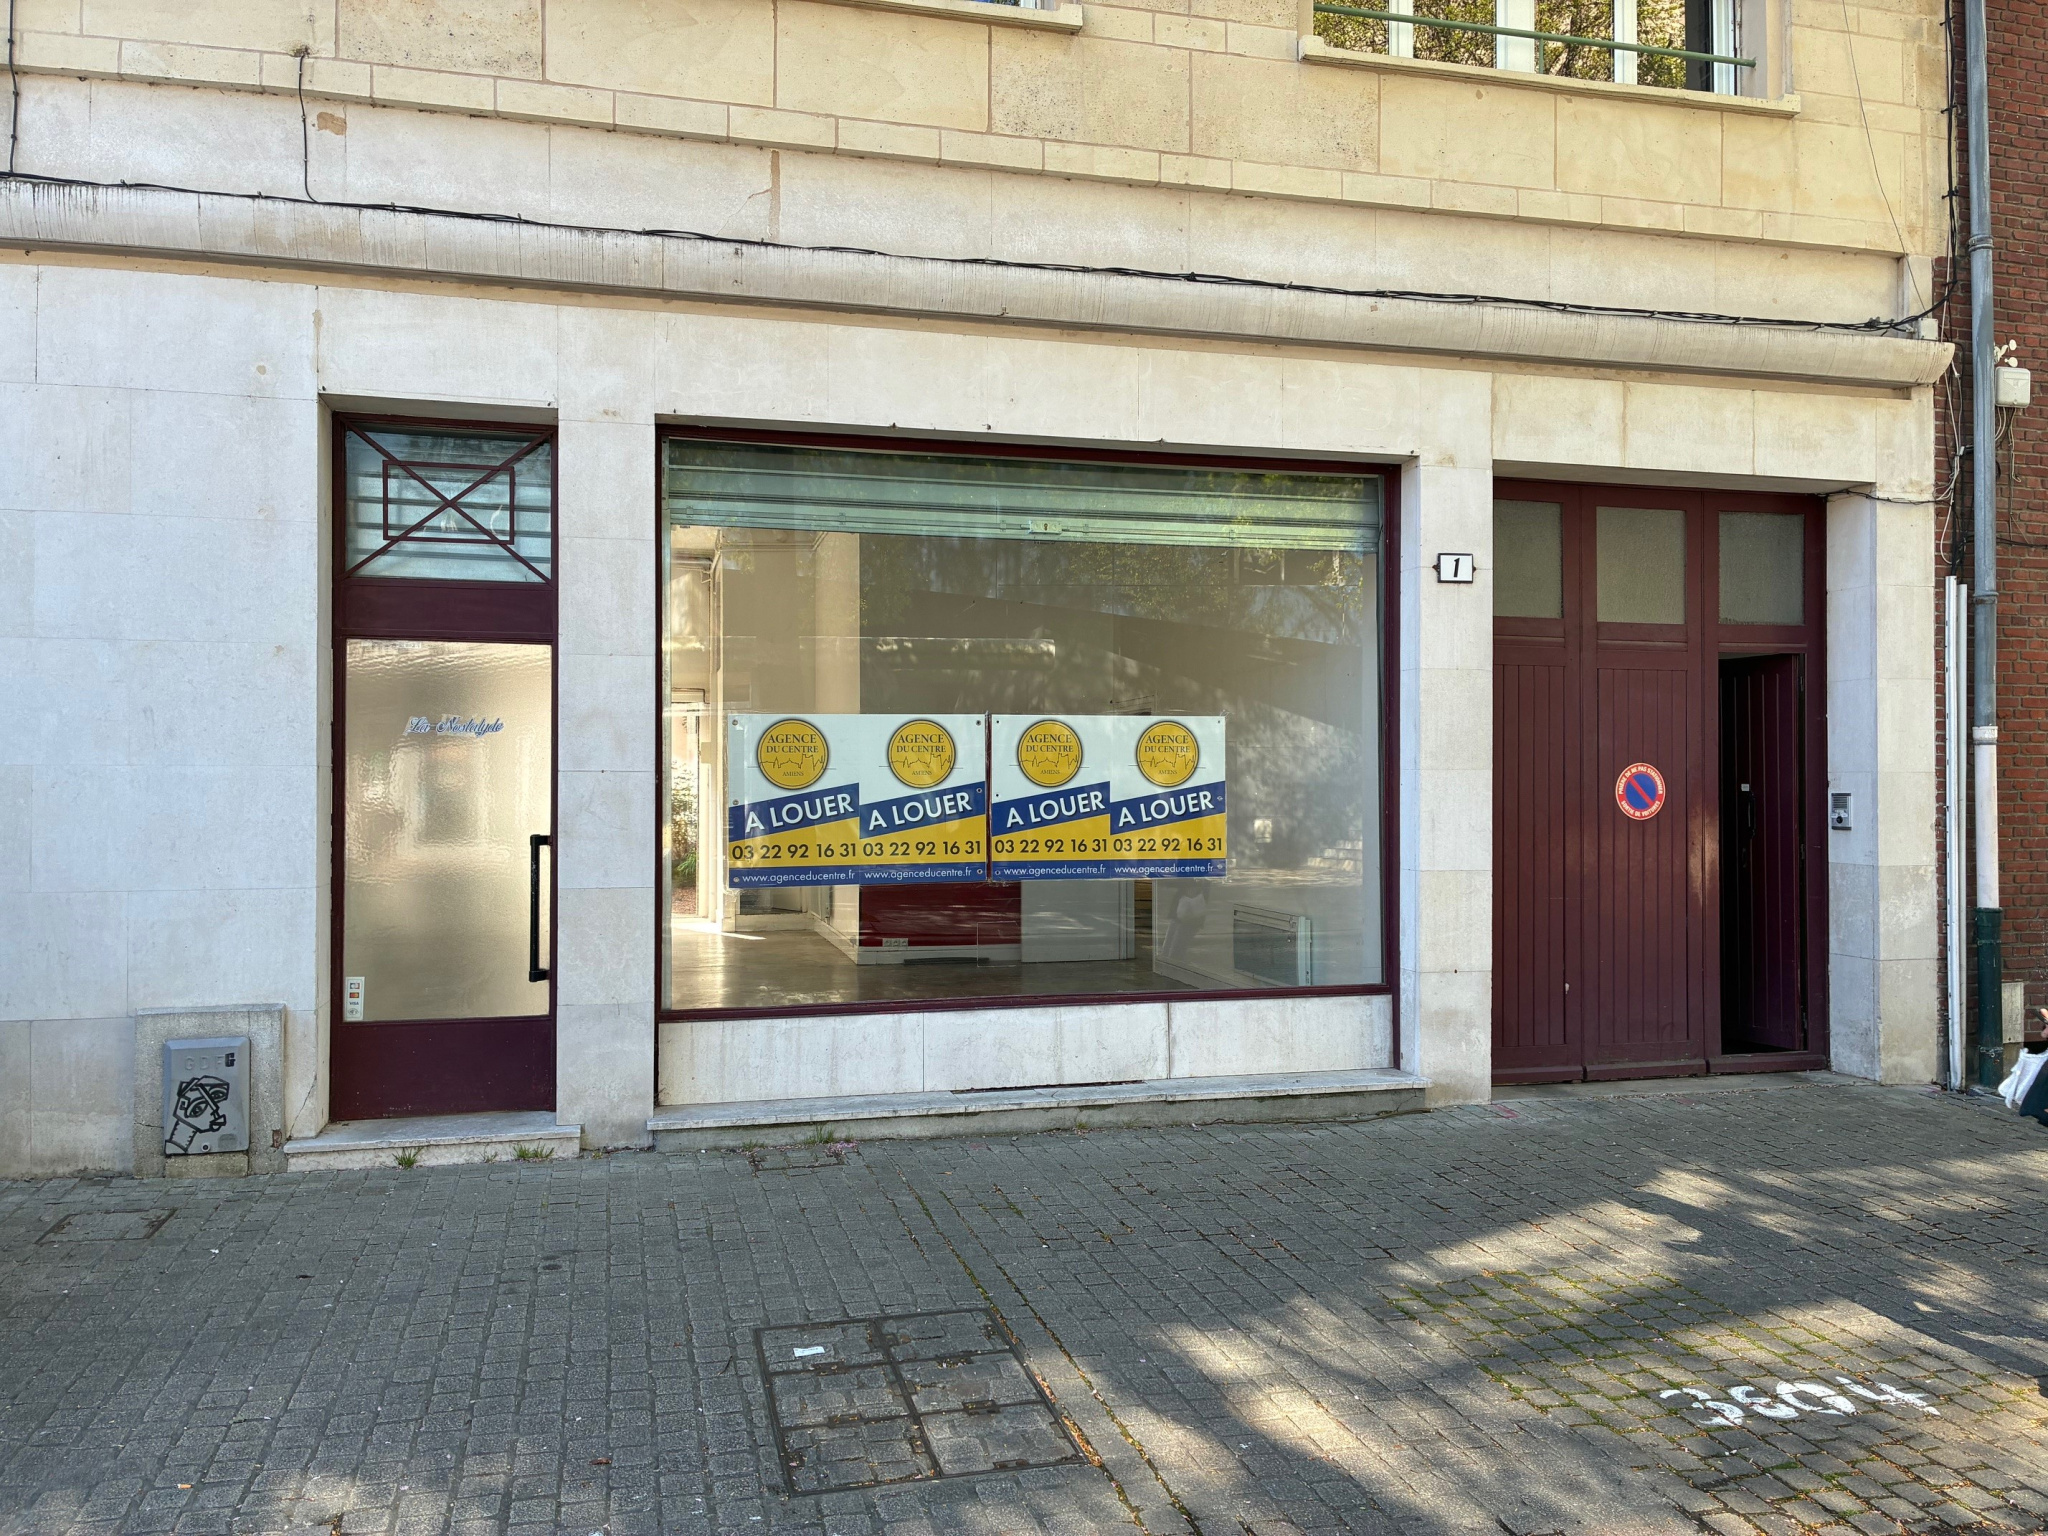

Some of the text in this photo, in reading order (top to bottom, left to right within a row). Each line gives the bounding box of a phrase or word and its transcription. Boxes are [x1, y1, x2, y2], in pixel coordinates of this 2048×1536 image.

[1453, 557, 1460, 578] 1
[768, 733, 816, 743] AGENCE
[898, 734, 944, 743] AGENCE
[1027, 734, 1071, 743] AGENCE
[1146, 735, 1188, 743] AGENCE
[782, 745, 819, 753] CENTRE
[1040, 744, 1074, 752] CENTRE
[1158, 745, 1190, 753] CENTRE
[745, 793, 854, 833] A LOUER
[869, 792, 972, 830] A LOUER
[1006, 791, 1105, 828] A LOUER
[1119, 791, 1214, 827] A LOUER
[732, 843, 856, 859] 03 22 92 16 31
[863, 841, 981, 856] 03 22 92 16 31
[995, 839, 1107, 853] 03 22 92 16 31
[1113, 838, 1222, 852] 03 22 92 16 31
[865, 867, 971, 880] www.agenceducentre.fr
[1004, 864, 1106, 876] www.agenceducentre.fr
[1115, 863, 1214, 874] www.agenceducentre.fr
[743, 871, 855, 883] www.agenceducentre.fr
